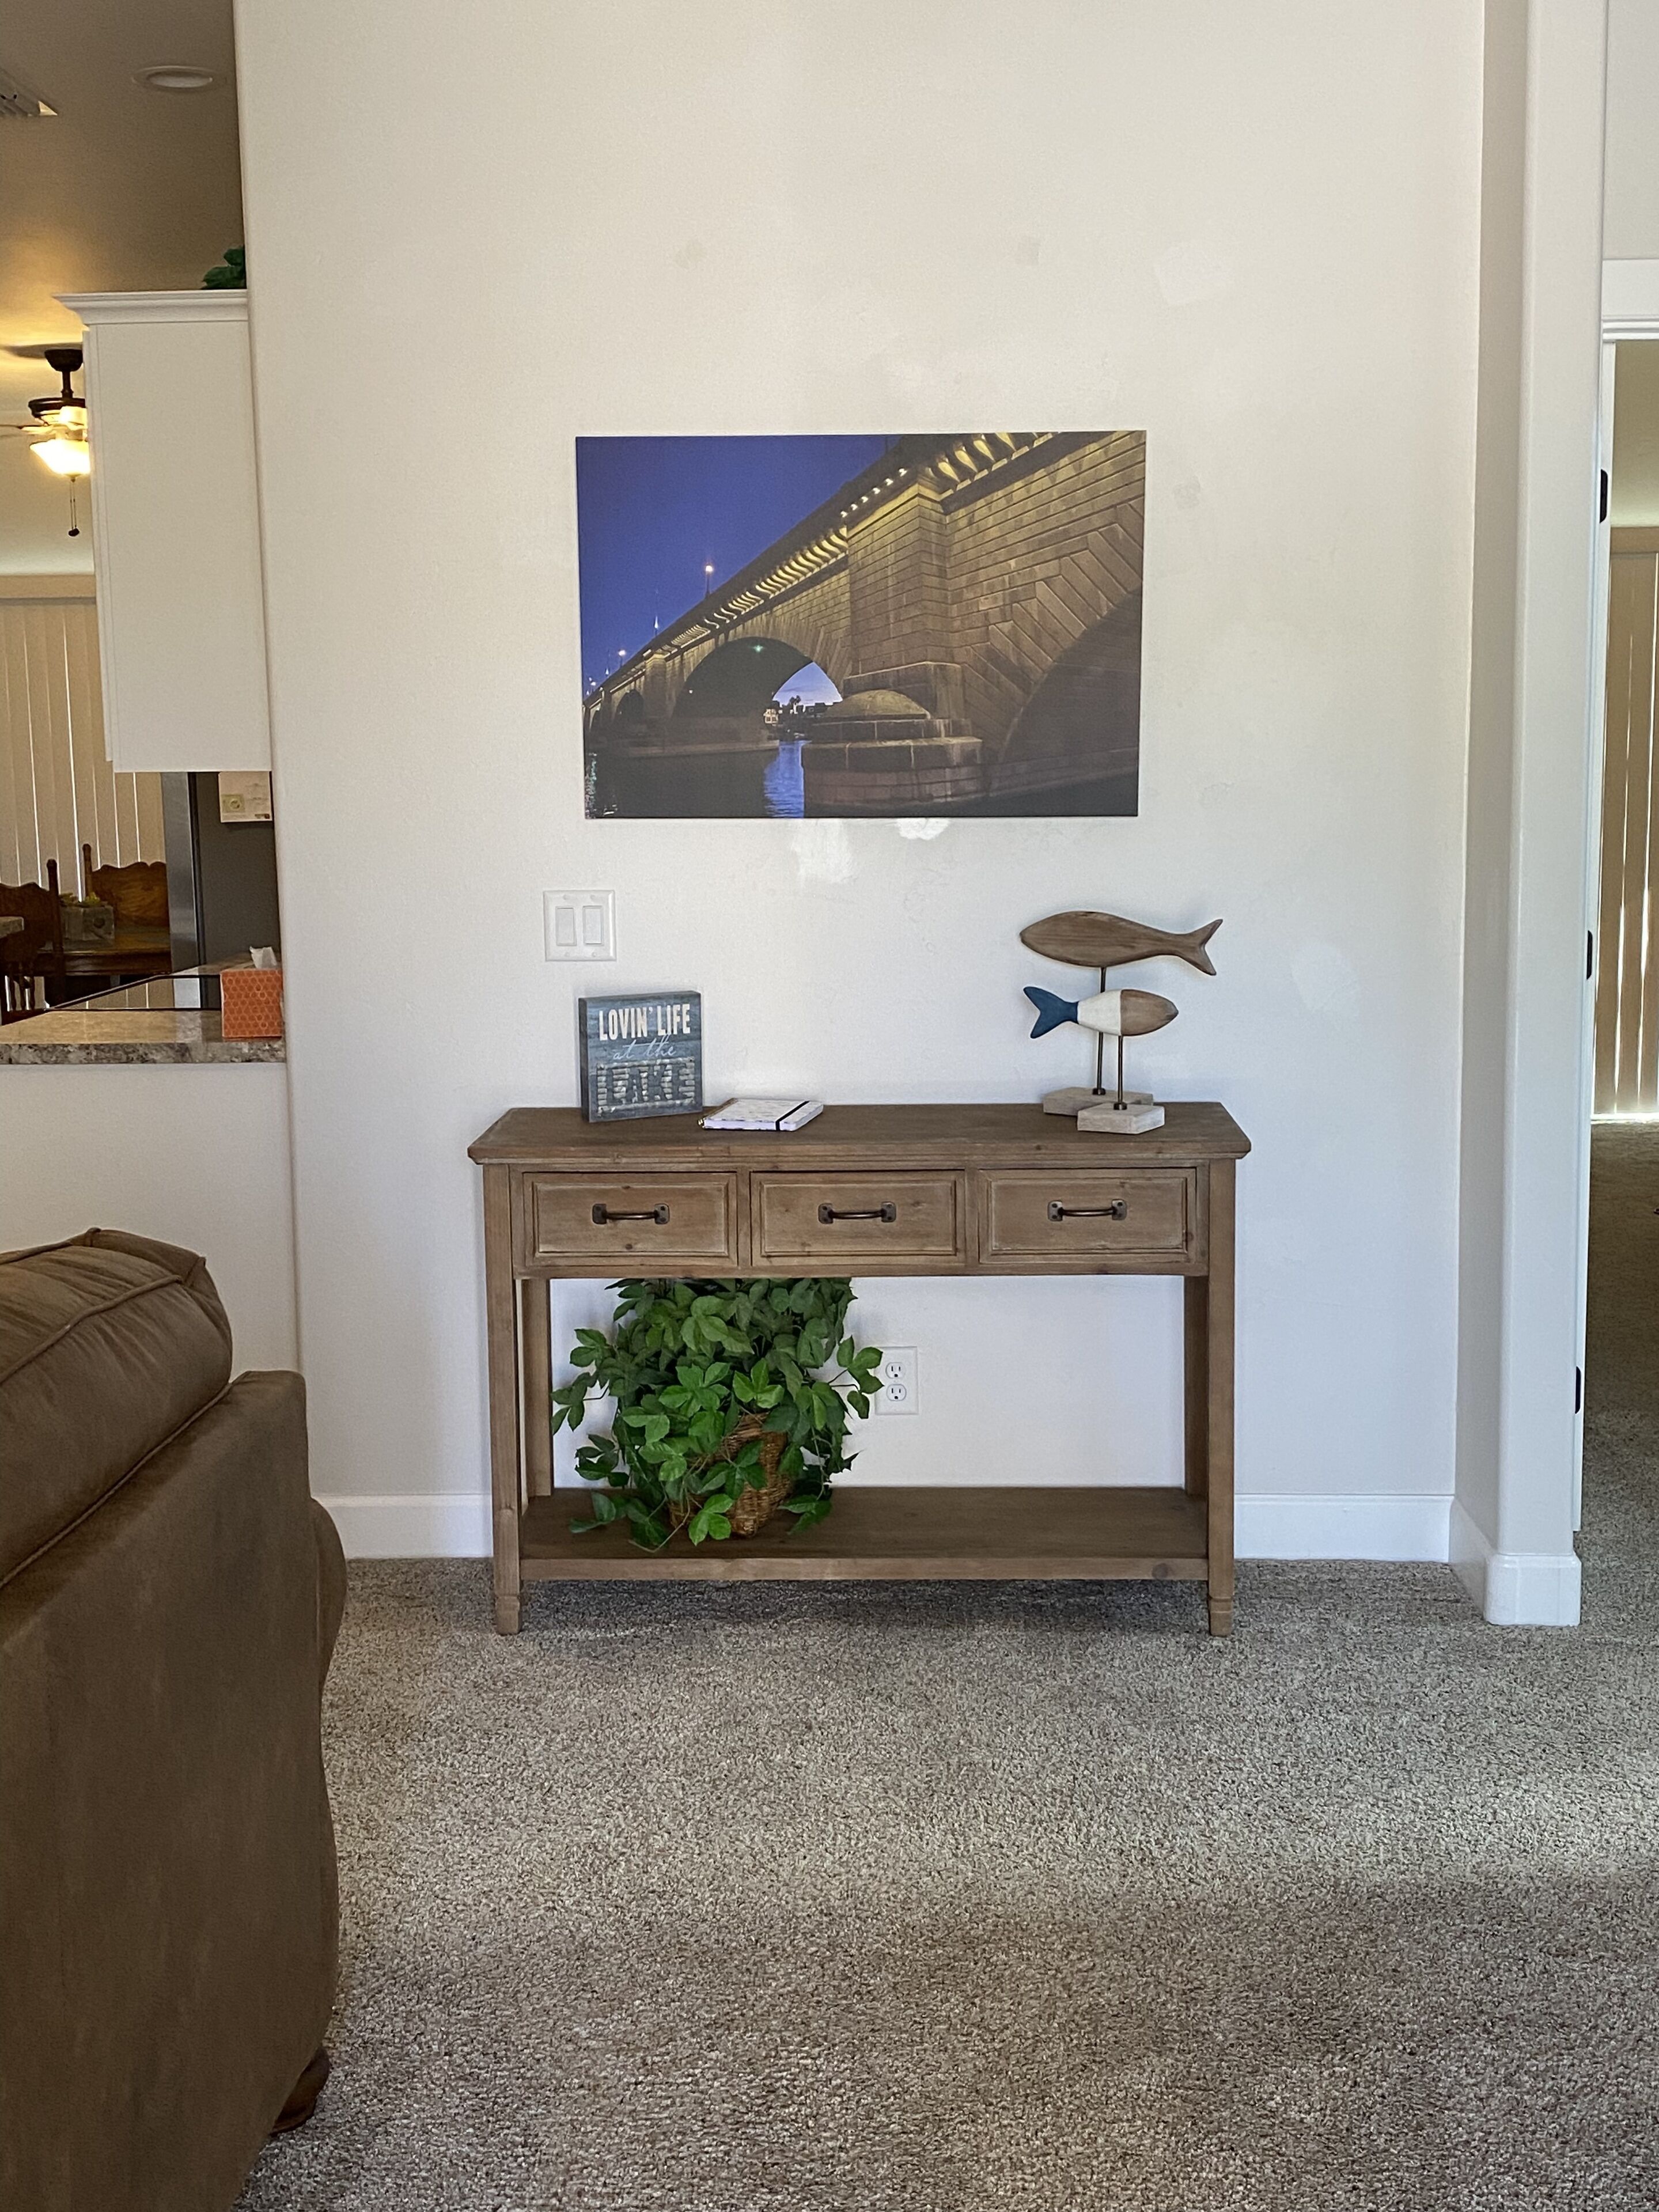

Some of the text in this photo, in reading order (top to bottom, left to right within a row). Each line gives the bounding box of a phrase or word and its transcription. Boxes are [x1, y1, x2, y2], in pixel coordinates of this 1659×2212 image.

[599, 1003, 690, 1041] LOVIN' LIFE
[612, 1034, 676, 1060] at the
